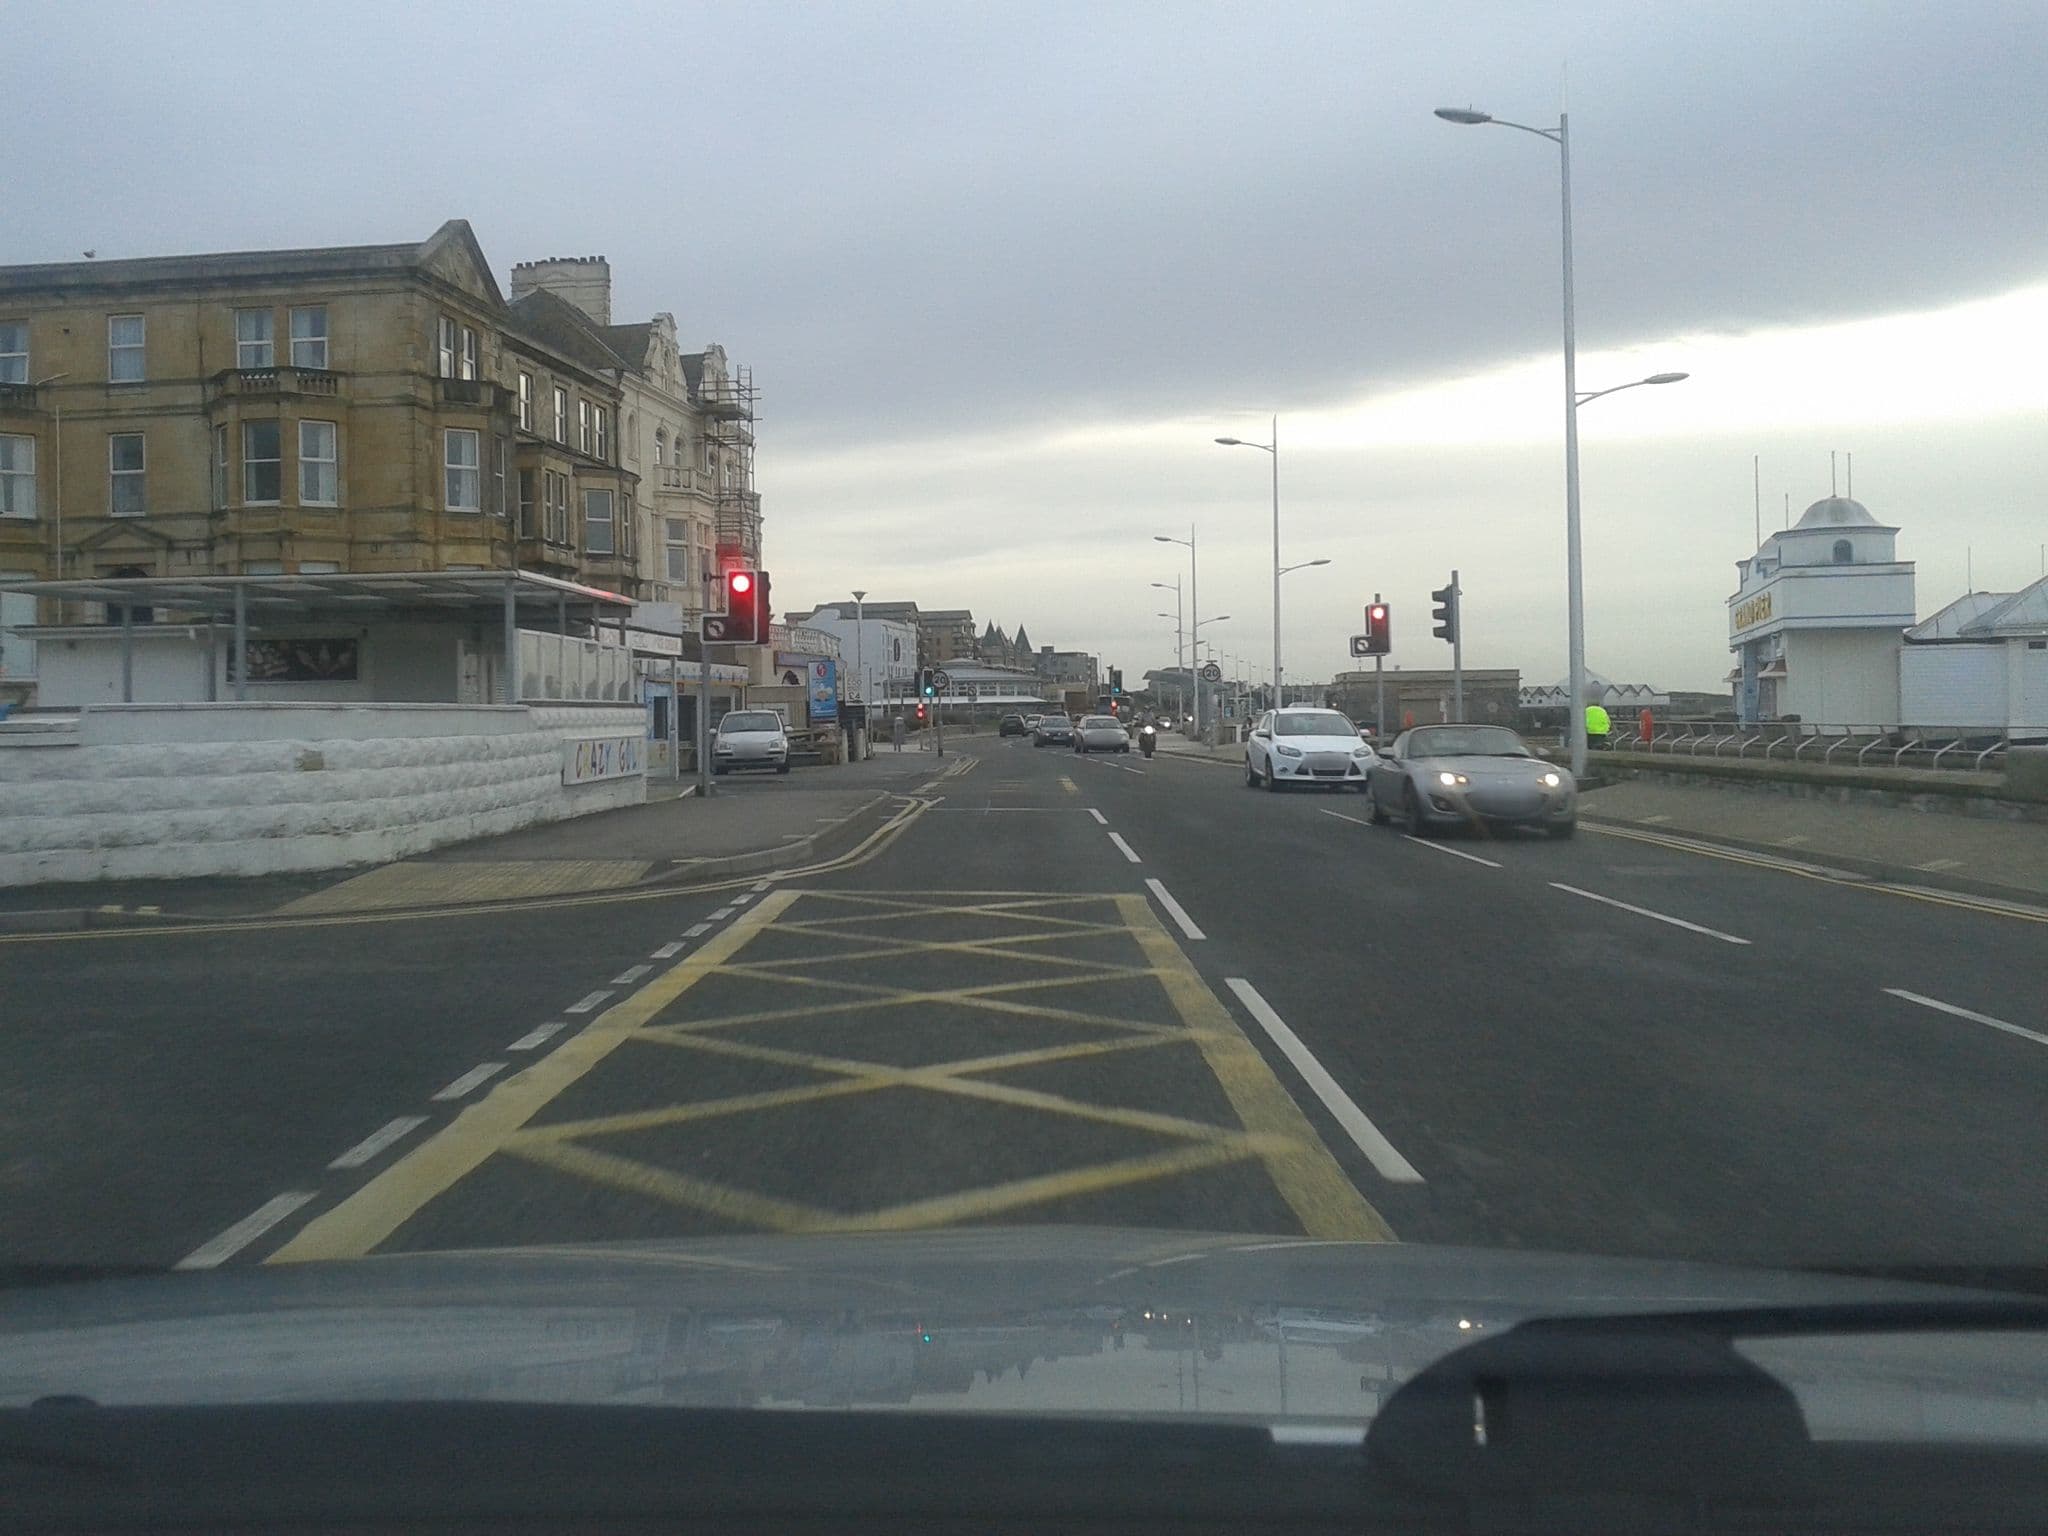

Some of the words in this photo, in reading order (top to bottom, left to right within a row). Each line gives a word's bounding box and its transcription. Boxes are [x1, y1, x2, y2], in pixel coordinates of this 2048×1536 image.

[1206, 669, 1218, 678] 20
[934, 675, 946, 684] 20
[576, 741, 611, 779] CRAZY
